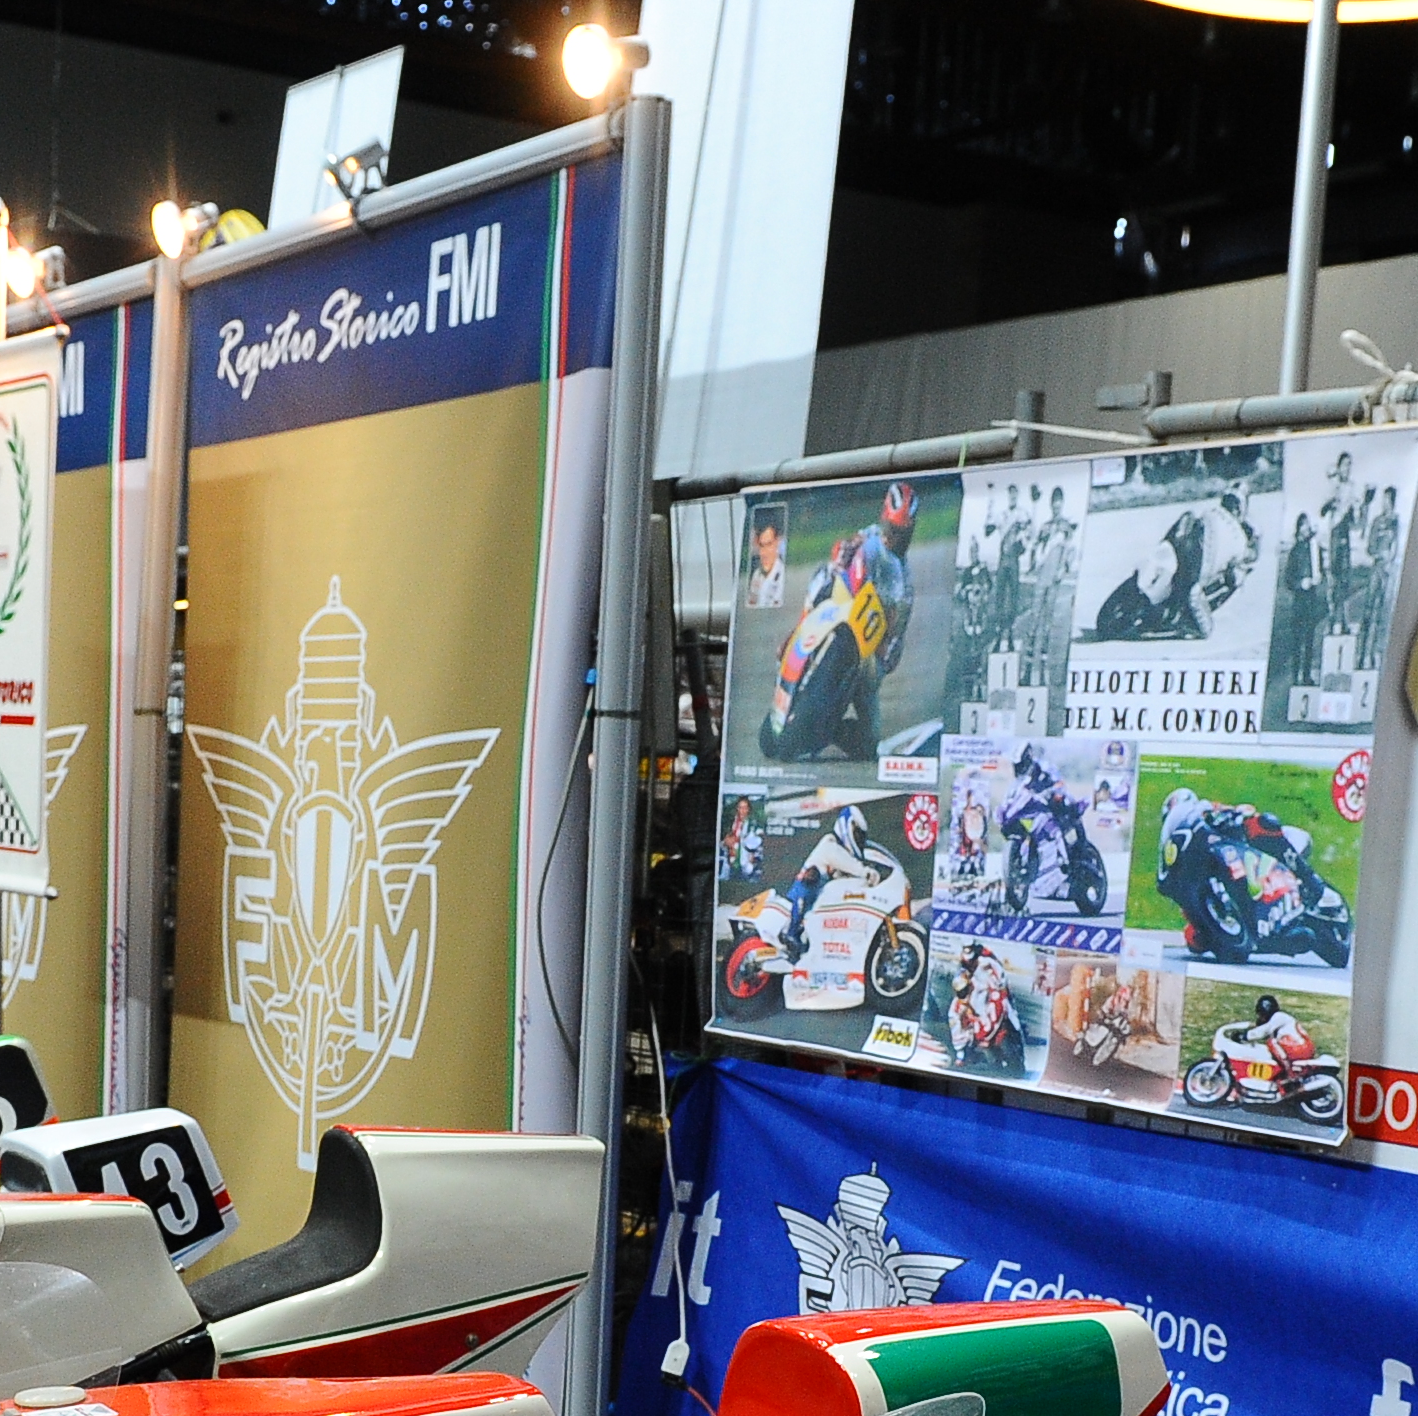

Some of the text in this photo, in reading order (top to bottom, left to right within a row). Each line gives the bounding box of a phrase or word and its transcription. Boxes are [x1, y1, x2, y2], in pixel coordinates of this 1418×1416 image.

[217, 222, 502, 400] Registro Storico FMI
[59, 341, 85, 418] MI
[1064, 706, 1099, 731] DEL
[1161, 708, 1258, 733] CONDOR
[1069, 669, 1258, 696] PILOTI DI IERI
[983, 1259, 1228, 1362] Fedione
